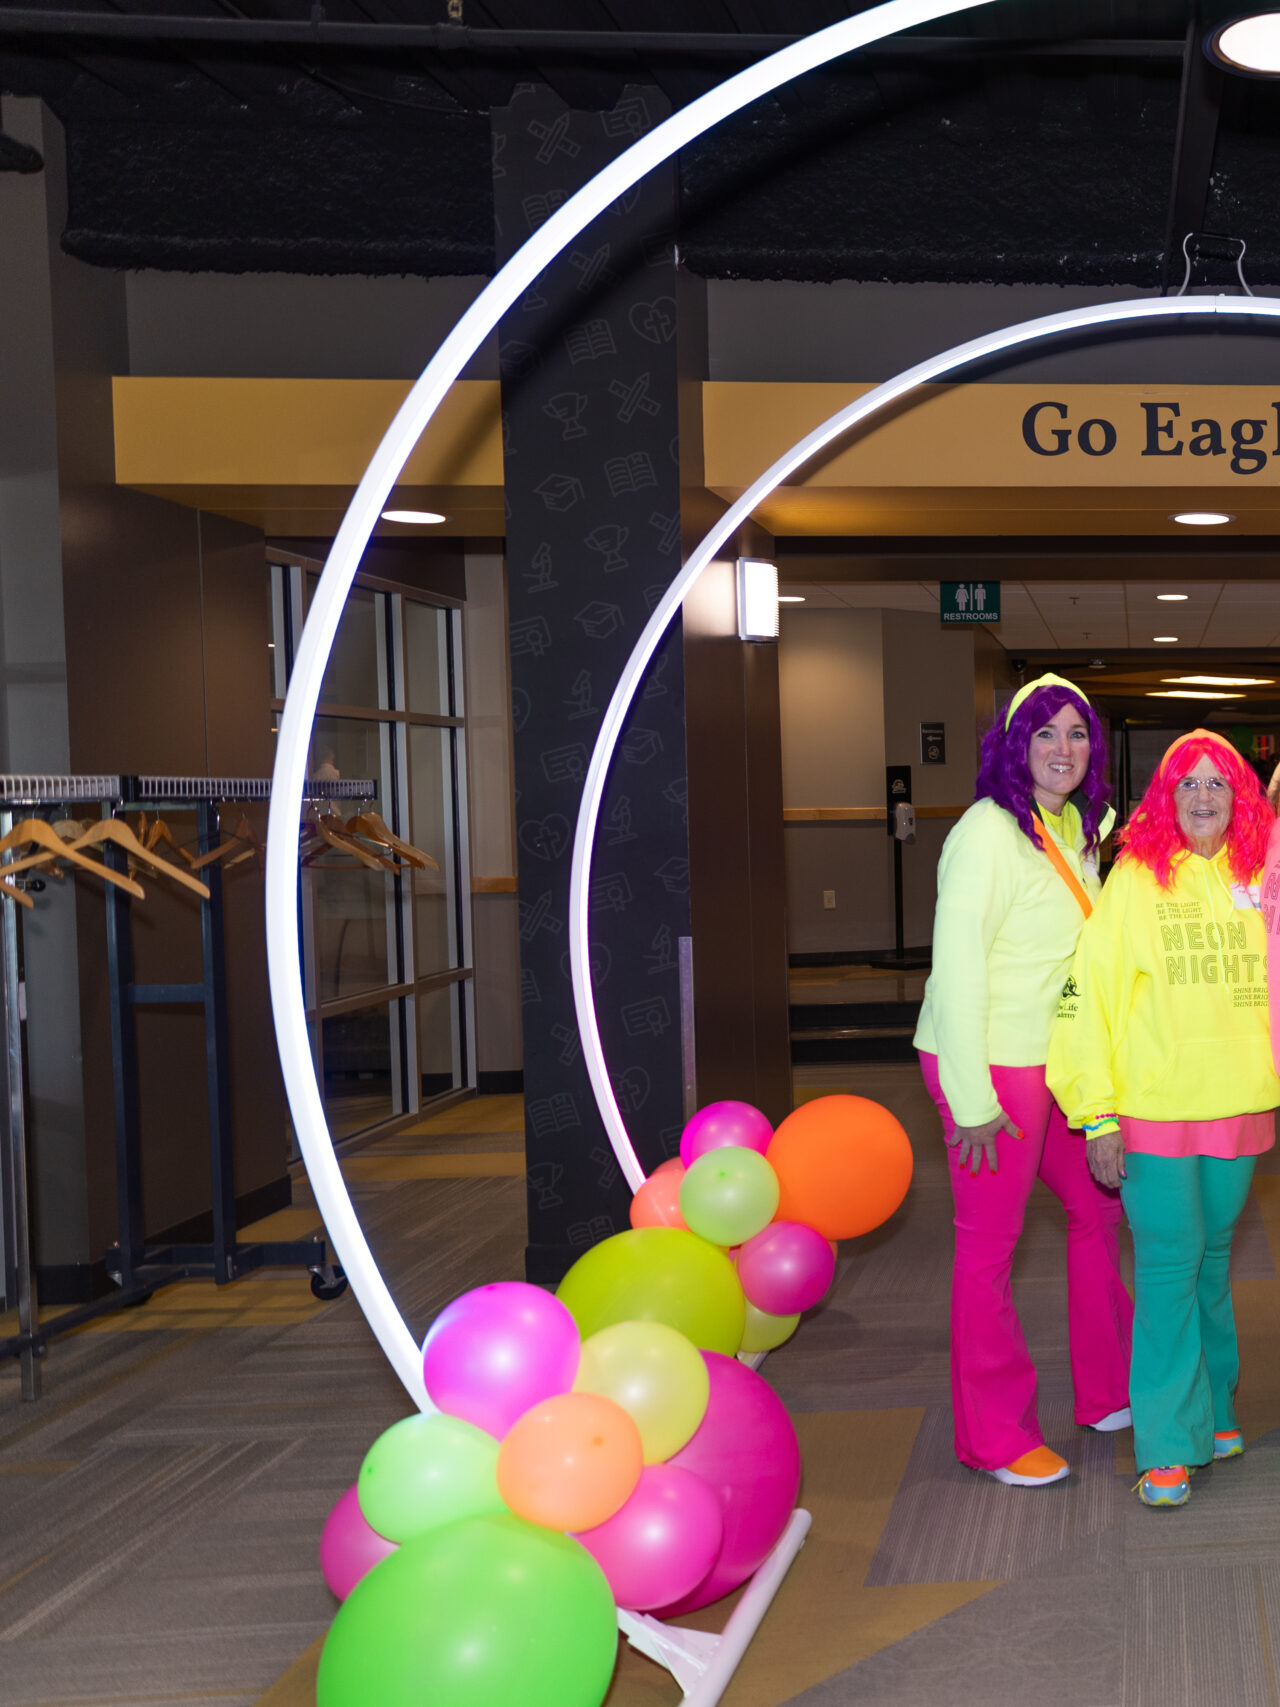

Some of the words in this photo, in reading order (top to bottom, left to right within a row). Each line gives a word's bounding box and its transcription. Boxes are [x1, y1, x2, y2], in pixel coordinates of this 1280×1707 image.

[1022, 401, 1117, 457] Go
[943, 612, 999, 621] RESTROOMS
[1160, 921, 1247, 951] NEON
[1165, 954, 1267, 985] NIGHT
